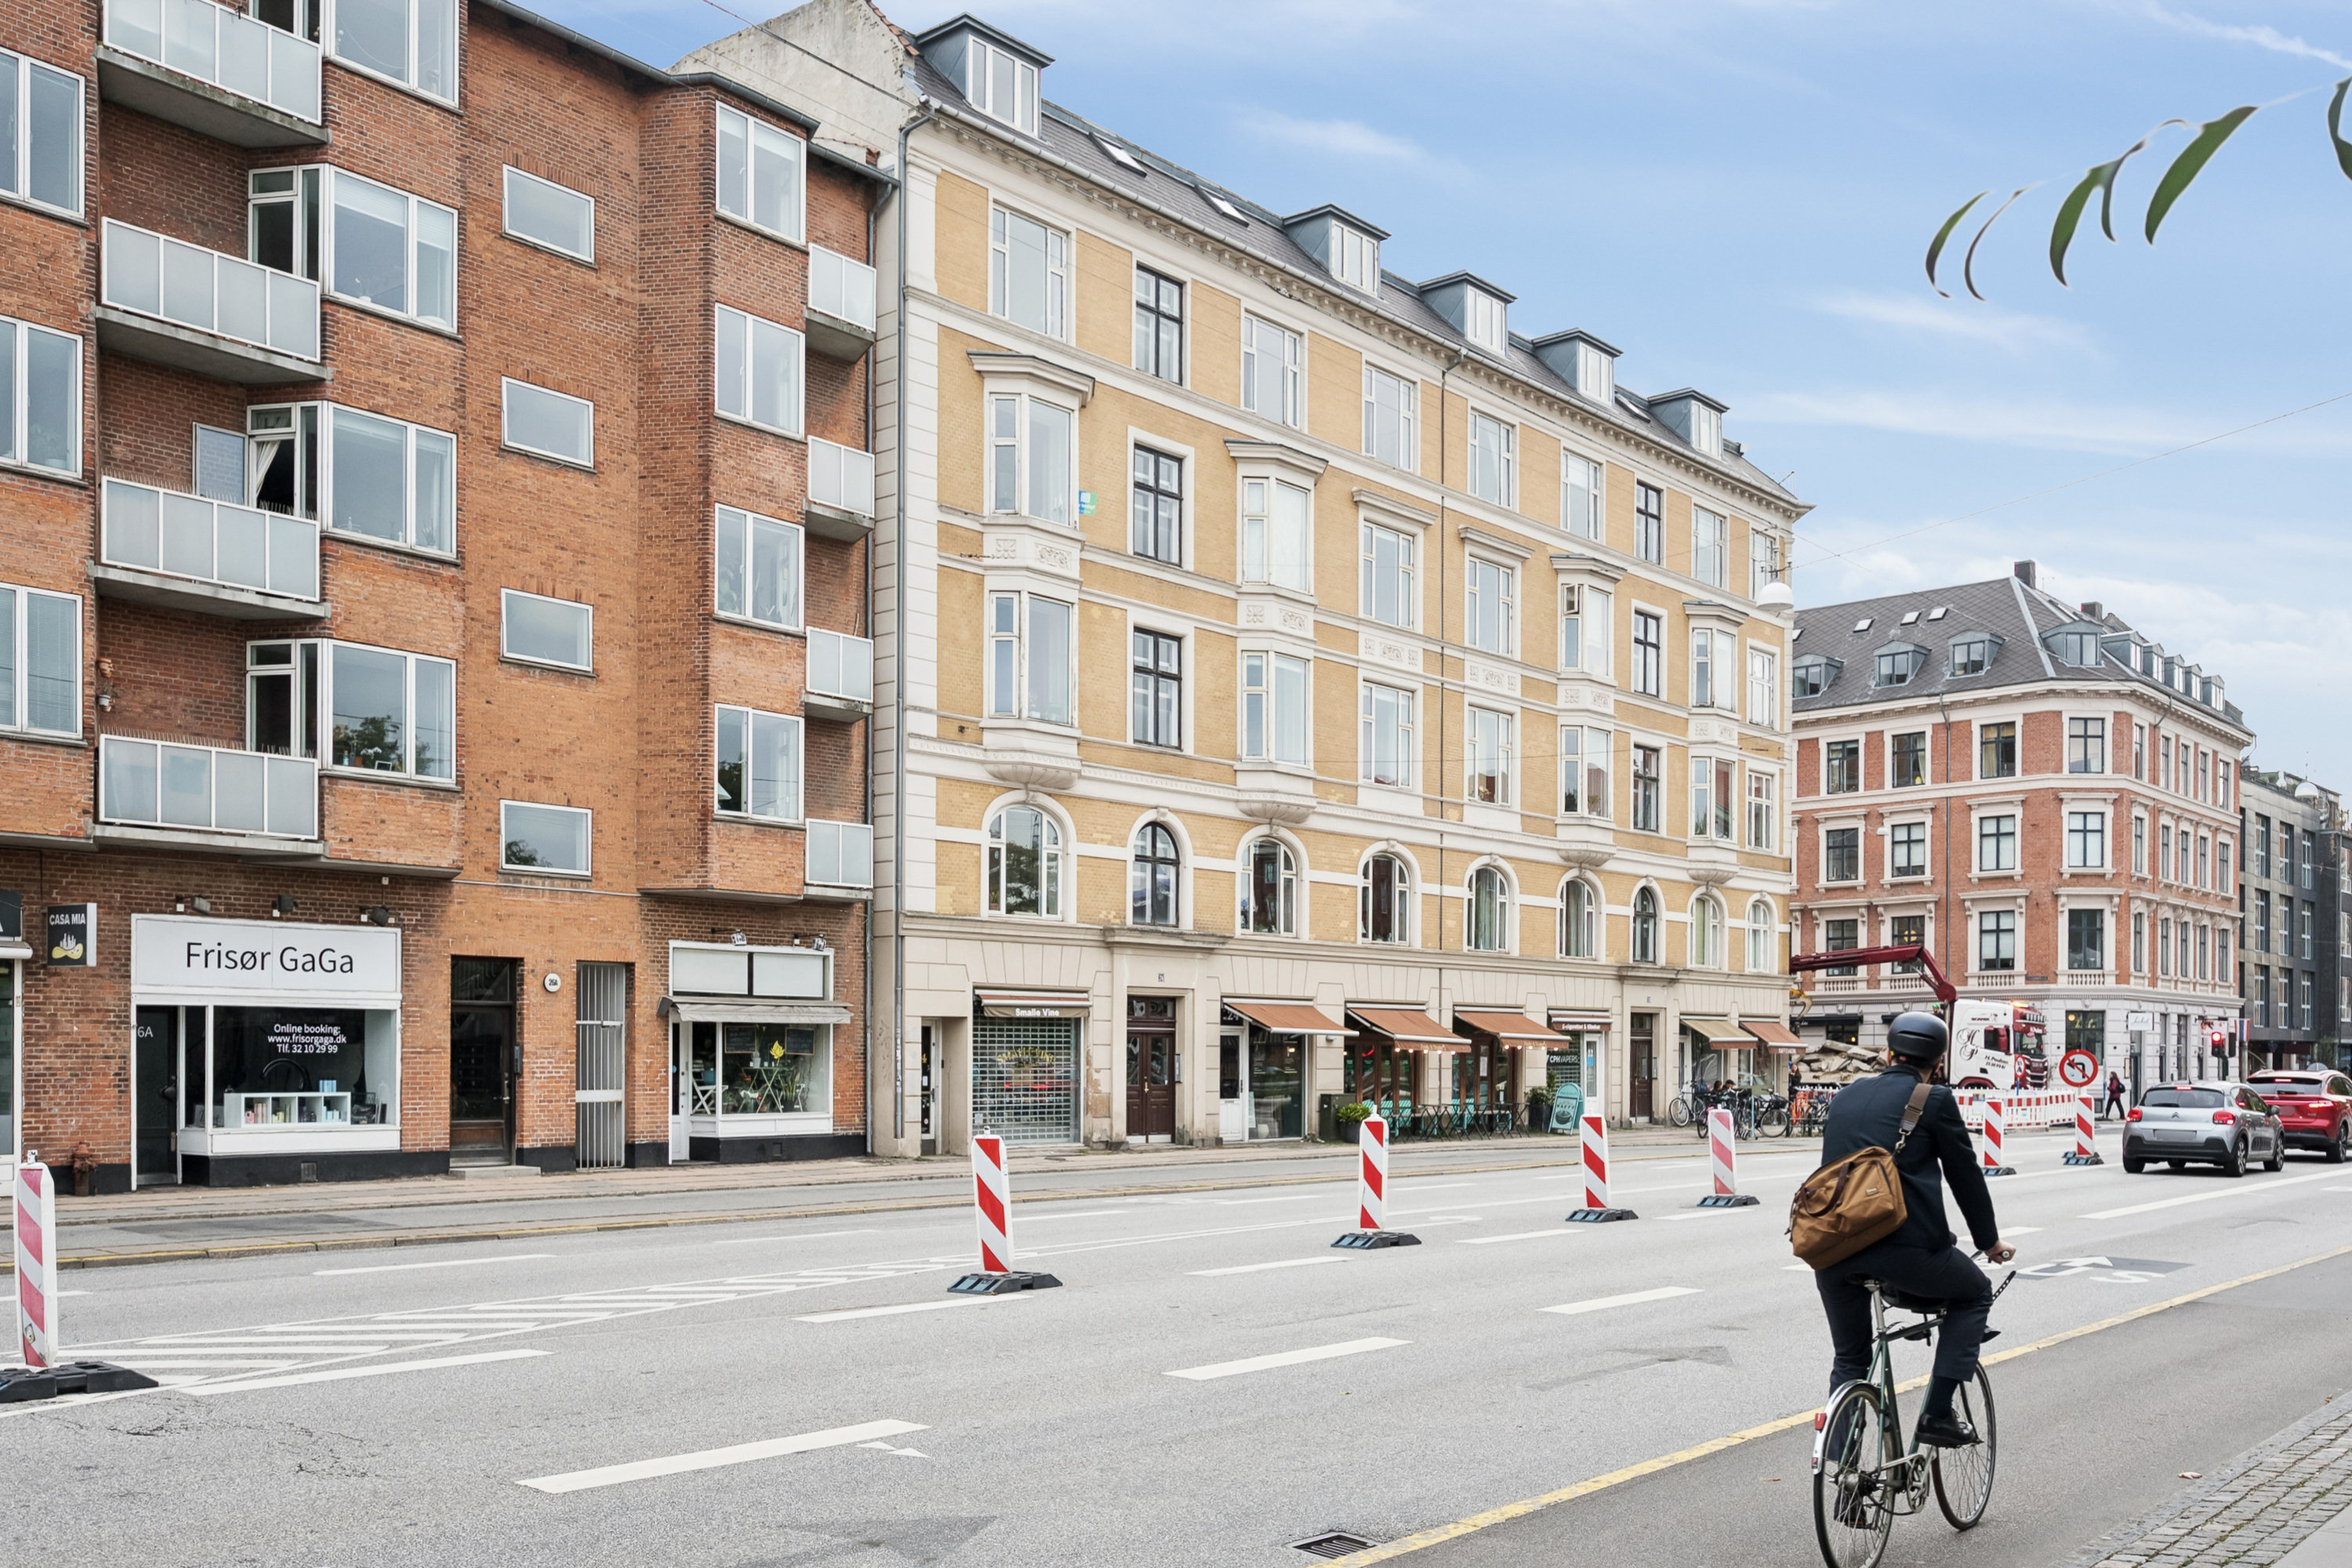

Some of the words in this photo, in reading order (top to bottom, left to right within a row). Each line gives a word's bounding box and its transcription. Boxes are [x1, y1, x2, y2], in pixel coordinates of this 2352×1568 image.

[49, 914, 71, 925] CASA
[71, 913, 86, 924] MIA
[187, 942, 271, 971] Frisør
[279, 946, 354, 974] GaGa
[1015, 1007, 1041, 1017] Smalle
[1042, 1008, 1060, 1017] Vine
[274, 1023, 303, 1033] Online
[303, 1023, 340, 1036] booking:
[267, 1033, 347, 1046] www.frisorgaga.dk
[277, 1044, 290, 1053] Tlf.
[292, 1044, 303, 1053] 32
[303, 1044, 314, 1053] 10
[315, 1044, 326, 1053] 29
